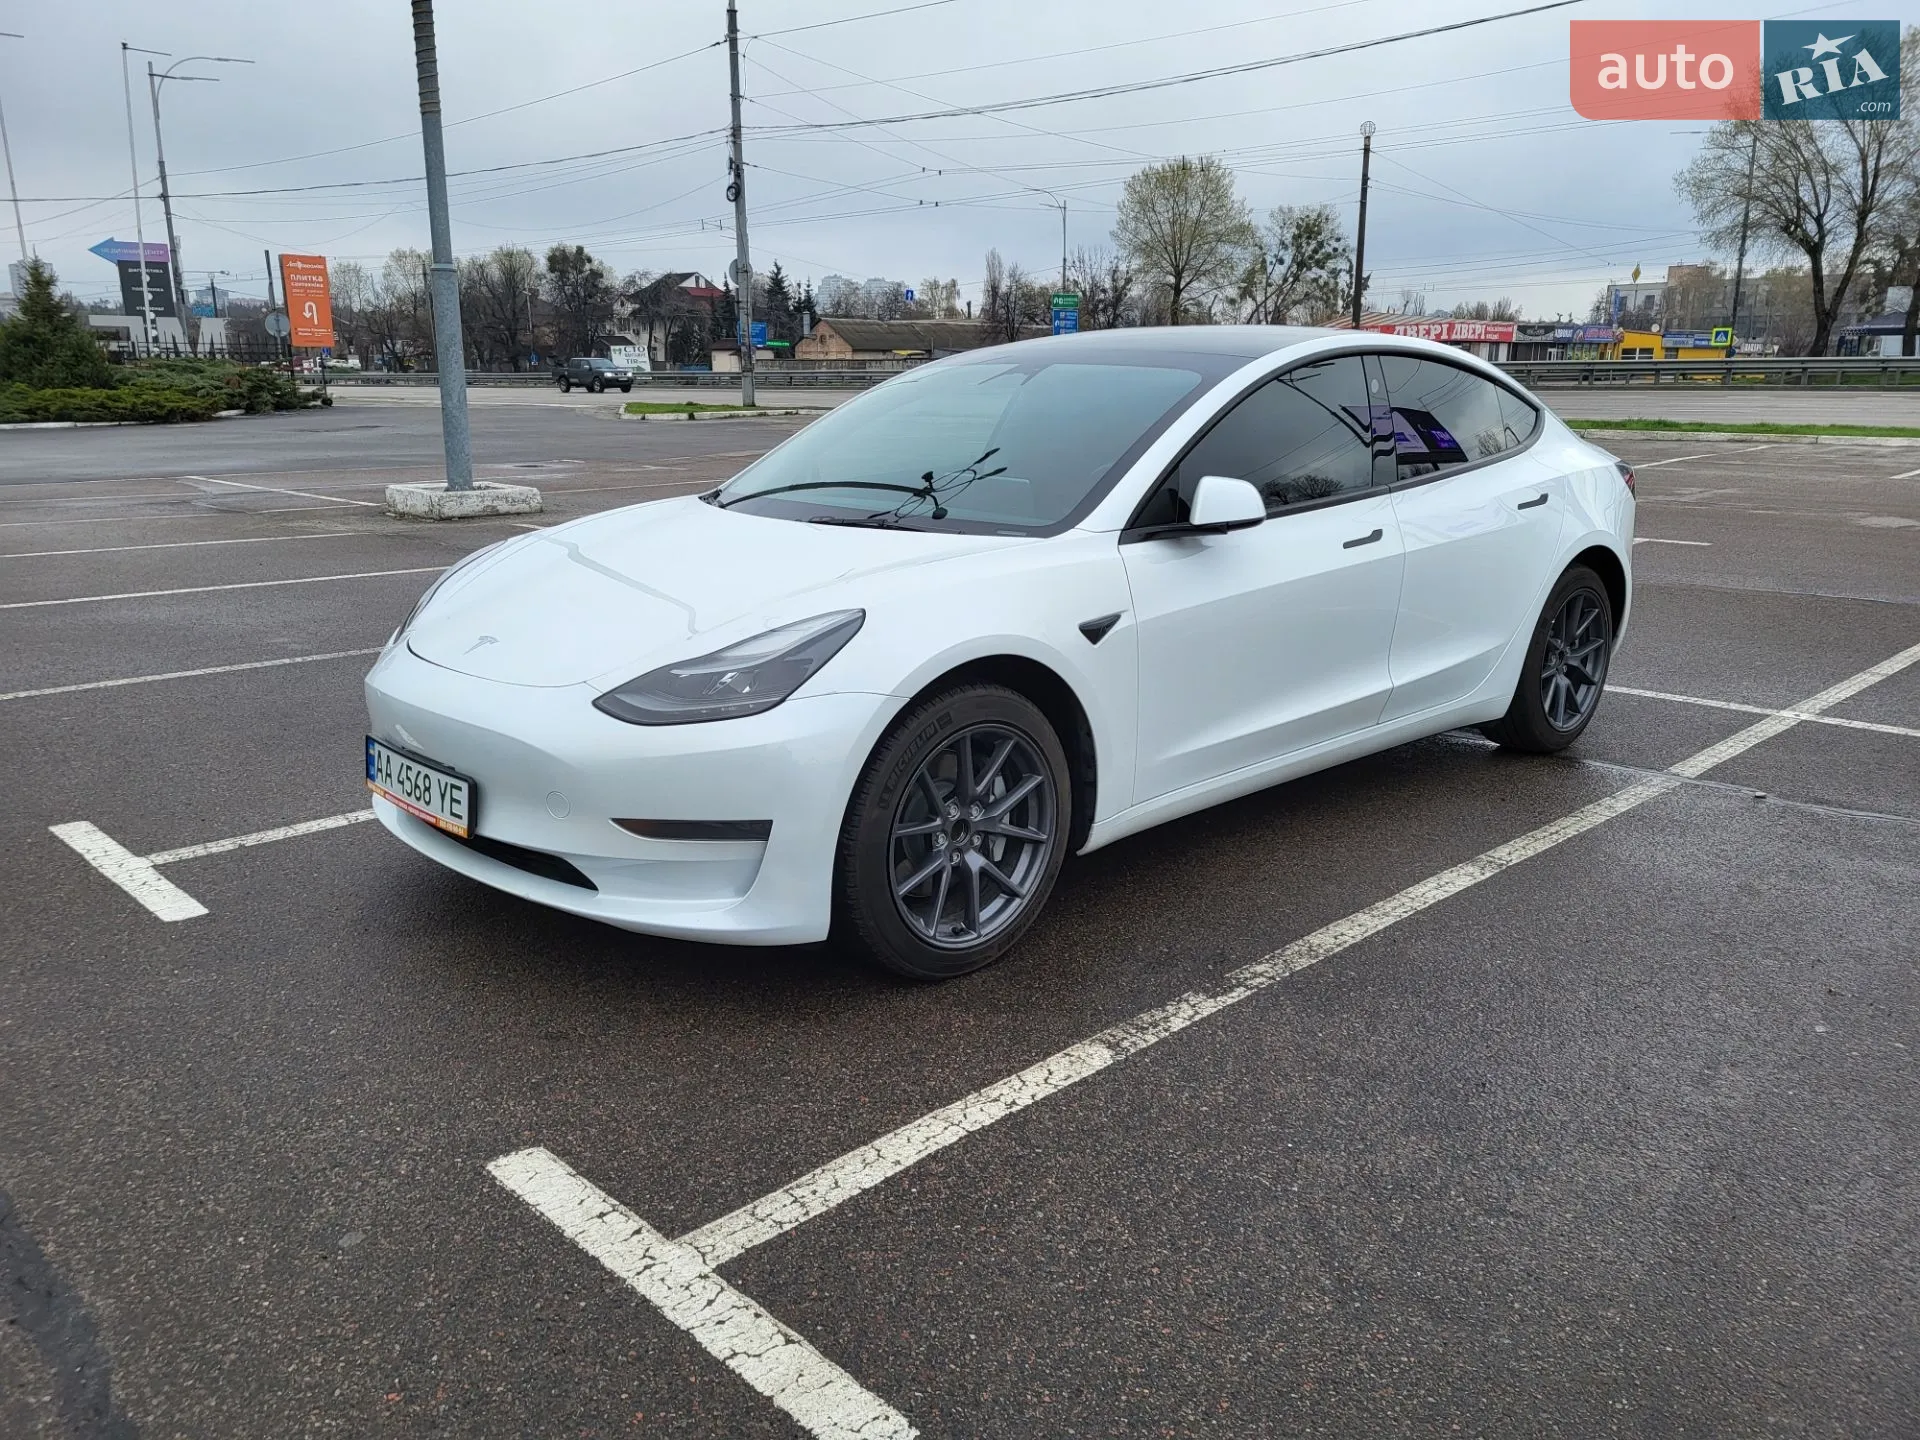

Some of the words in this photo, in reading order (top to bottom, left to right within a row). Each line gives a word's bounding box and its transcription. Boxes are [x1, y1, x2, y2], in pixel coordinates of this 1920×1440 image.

[1452, 323, 1486, 340] ДВЕРІ
[376, 750, 394, 788] AA
[397, 761, 432, 806] 4568
[438, 778, 463, 820] YE
